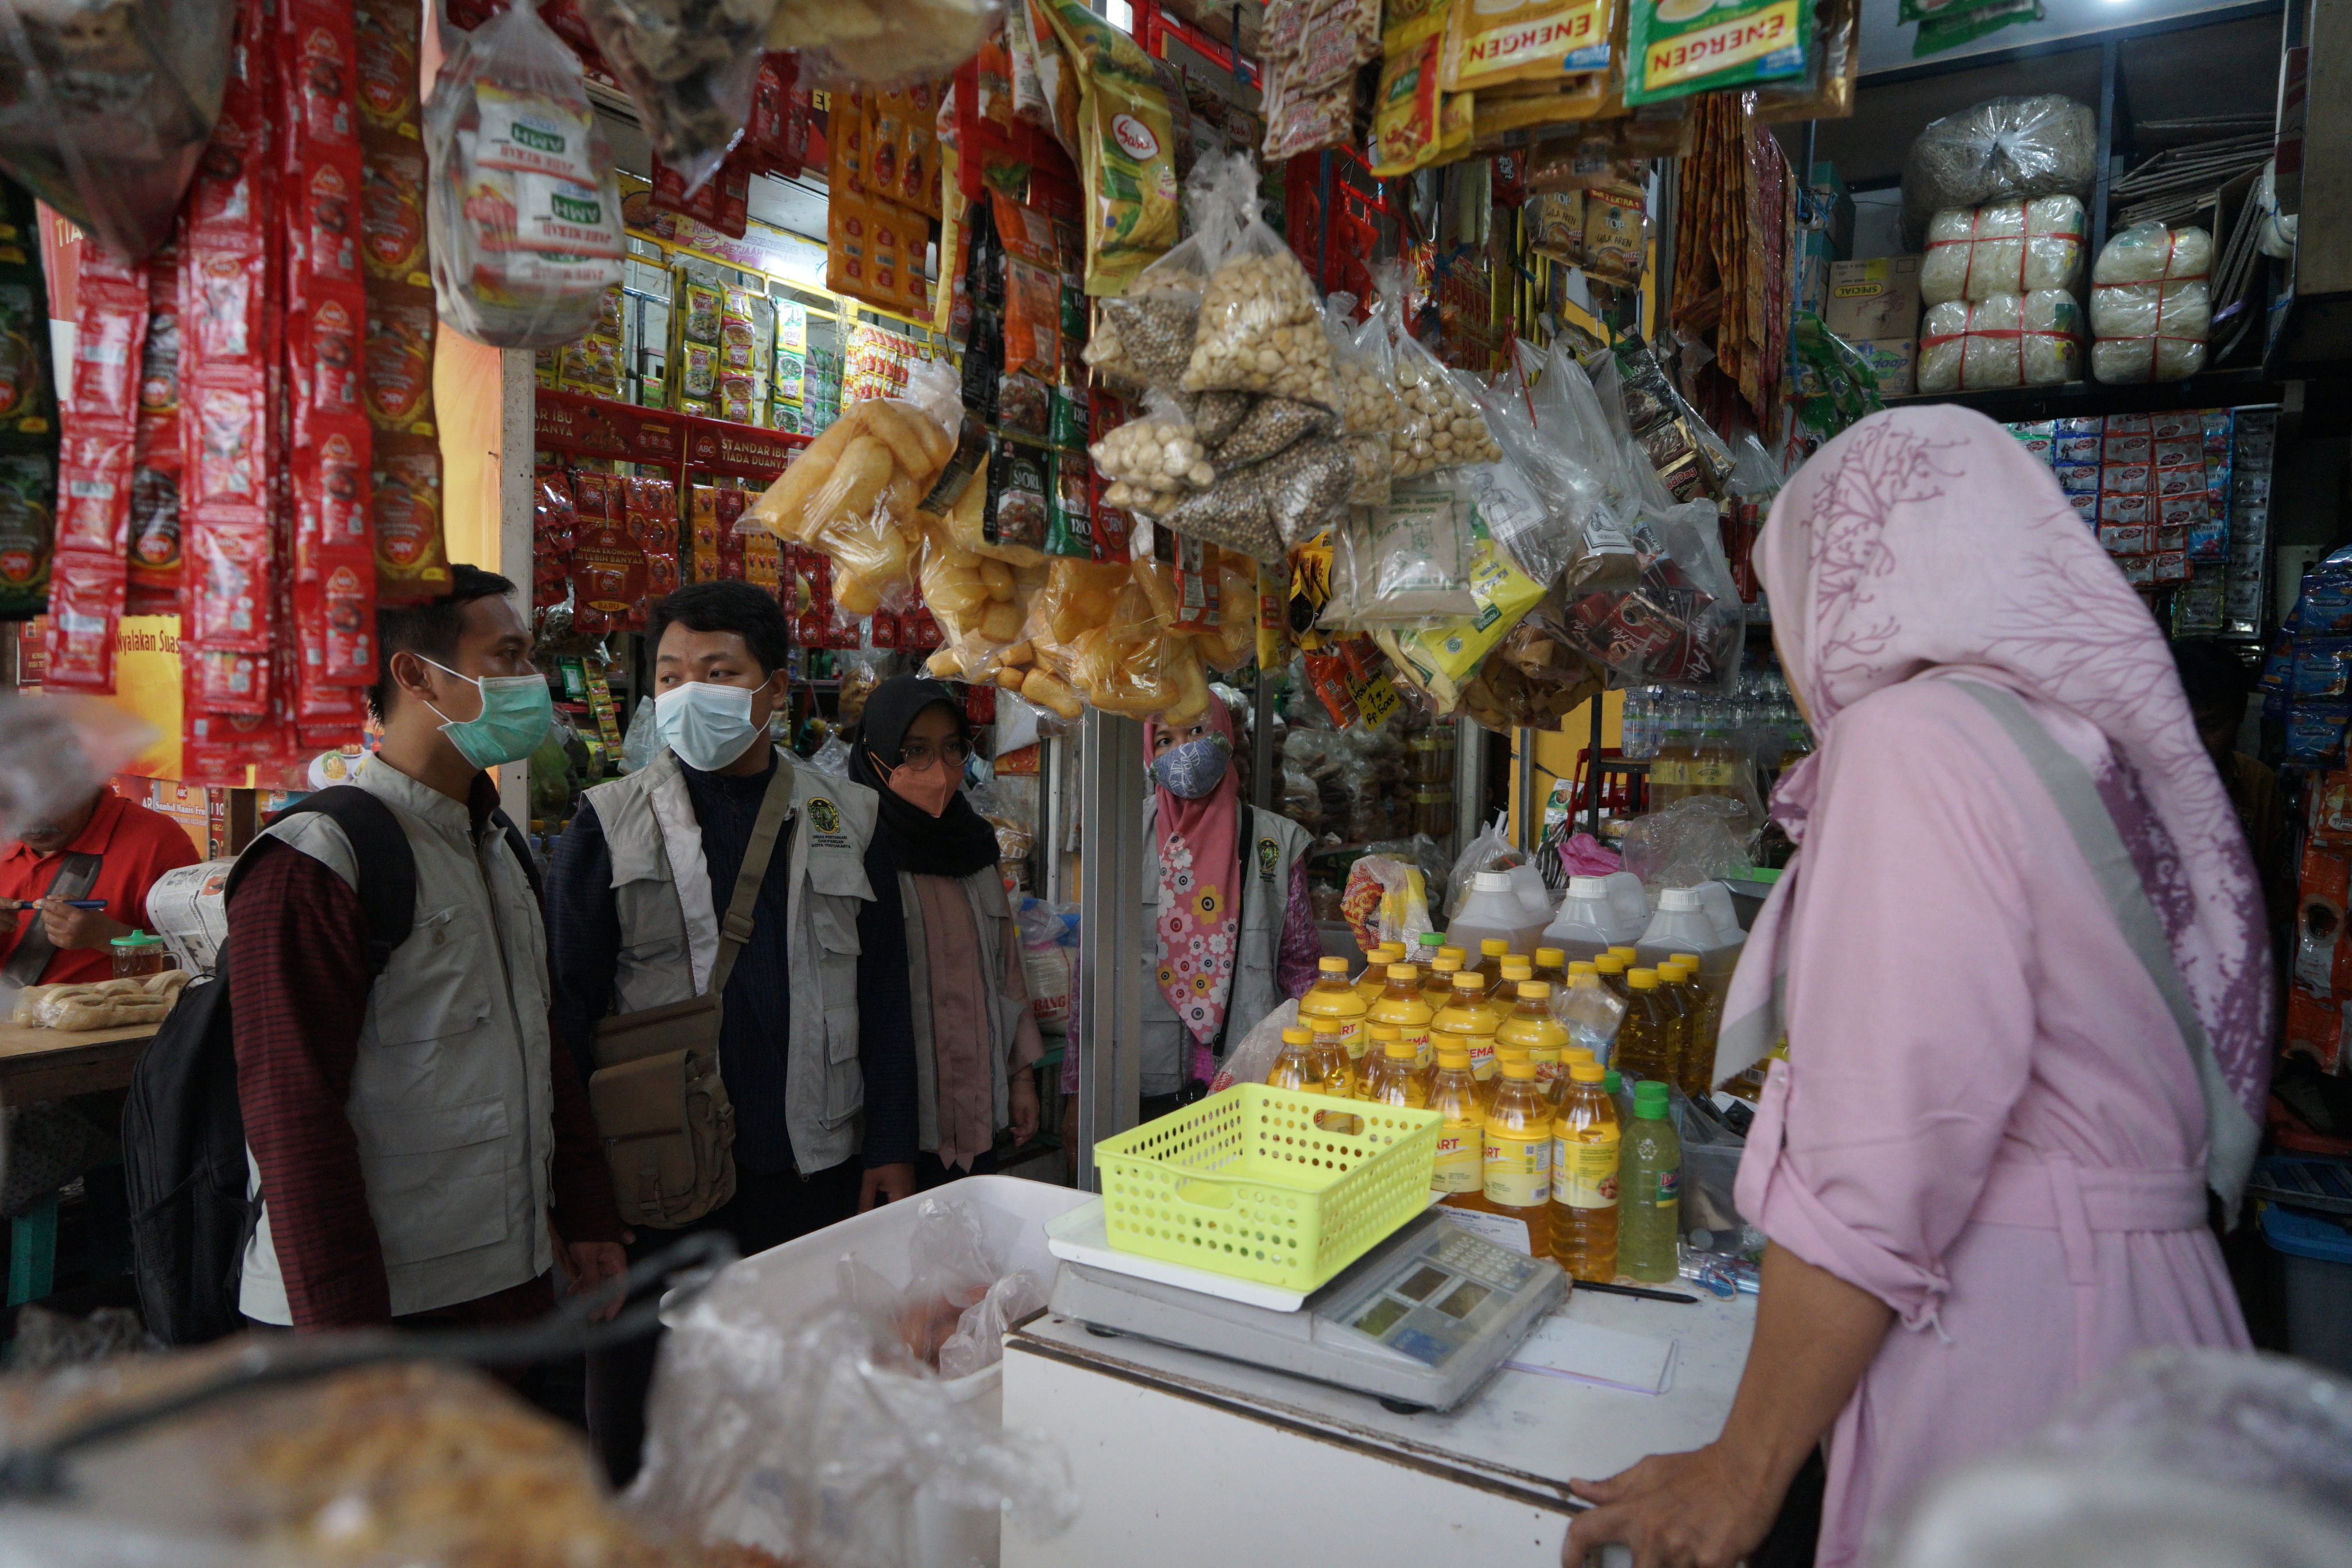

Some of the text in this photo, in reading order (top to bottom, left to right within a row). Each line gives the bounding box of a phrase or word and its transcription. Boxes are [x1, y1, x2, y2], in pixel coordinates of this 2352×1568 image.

[1470, 13, 1592, 63] ENERGEN
[1653, 14, 1785, 73] ENERGEN
[1553, 192, 1572, 206] TOP
[1611, 195, 1634, 207] EXTRA
[1604, 216, 1626, 231] TOP
[1840, 287, 1878, 295] SPECIAL
[693, 298, 713, 311] Racik
[784, 331, 801, 341] Racik
[597, 347, 615, 358] Racik
[729, 353, 749, 364] Racik
[689, 354, 709, 366] Racik
[782, 384, 799, 394] Racik
[552, 409, 573, 425] IBU
[730, 408, 749, 419] Racik
[698, 445, 714, 454] ABC
[721, 438, 788, 459] STANDAR IBU
[721, 451, 788, 470] TIADA DUANYA
[1677, 466, 1698, 483] Day
[586, 490, 601, 500] ABC
[1103, 516, 1124, 533] ABC
[578, 545, 642, 557] HARGA EKONOMIS
[610, 556, 645, 564] BANYAK
[598, 602, 620, 610] BARU
[117, 629, 182, 656] Nyalakan Suas
[1378, 694, 1396, 715] 5000
[177, 789, 188, 797] ABC
[155, 800, 175, 812] Sambal
[176, 803, 194, 814] Manis
[1339, 1023, 1356, 1035] RT
